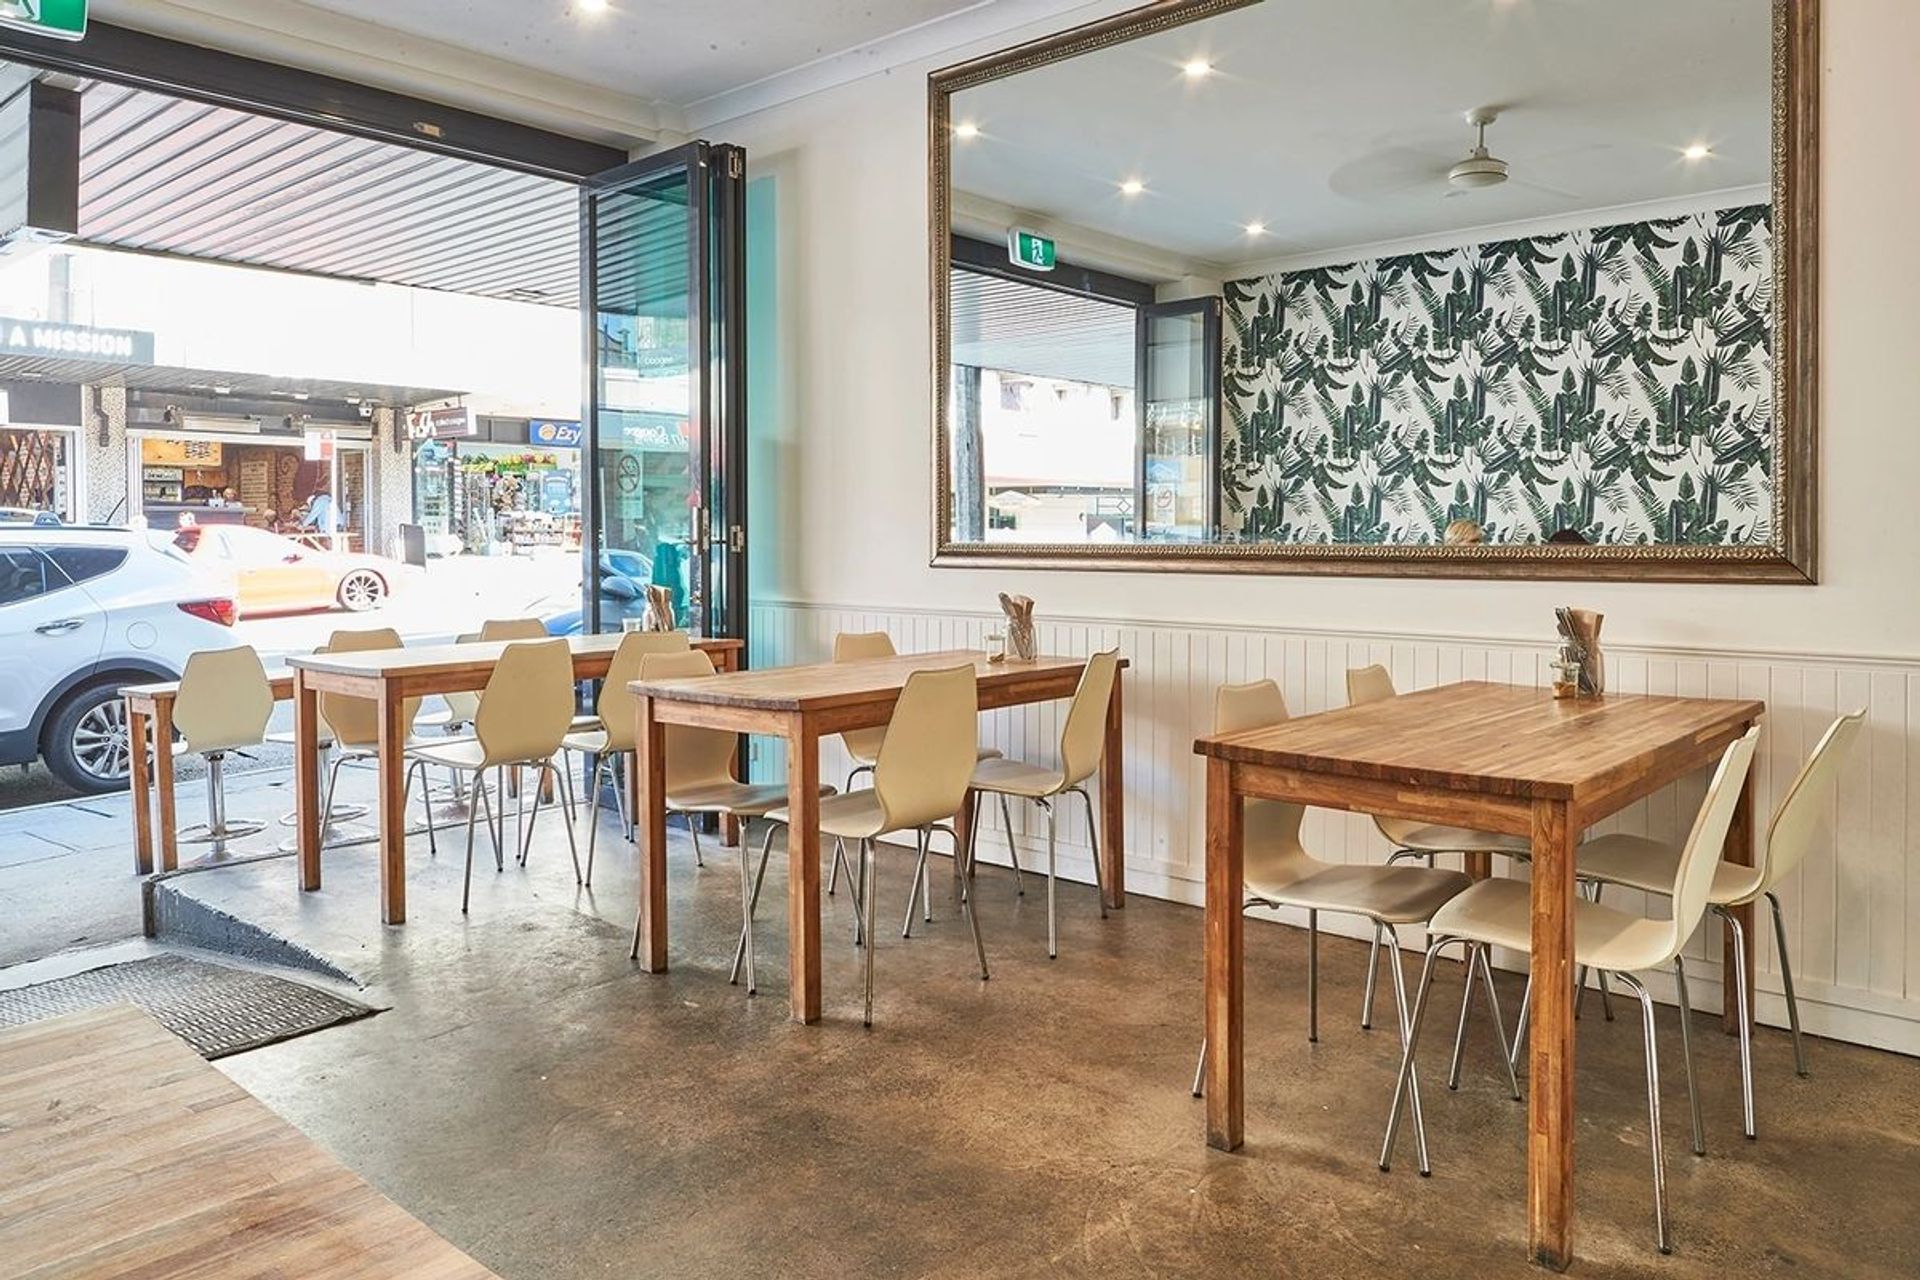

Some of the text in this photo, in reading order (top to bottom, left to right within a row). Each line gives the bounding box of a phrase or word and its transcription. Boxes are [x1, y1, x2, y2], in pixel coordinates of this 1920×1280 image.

[9, 325, 27, 347] A
[33, 327, 132, 357] MISSION
[556, 425, 582, 445] Ezy
